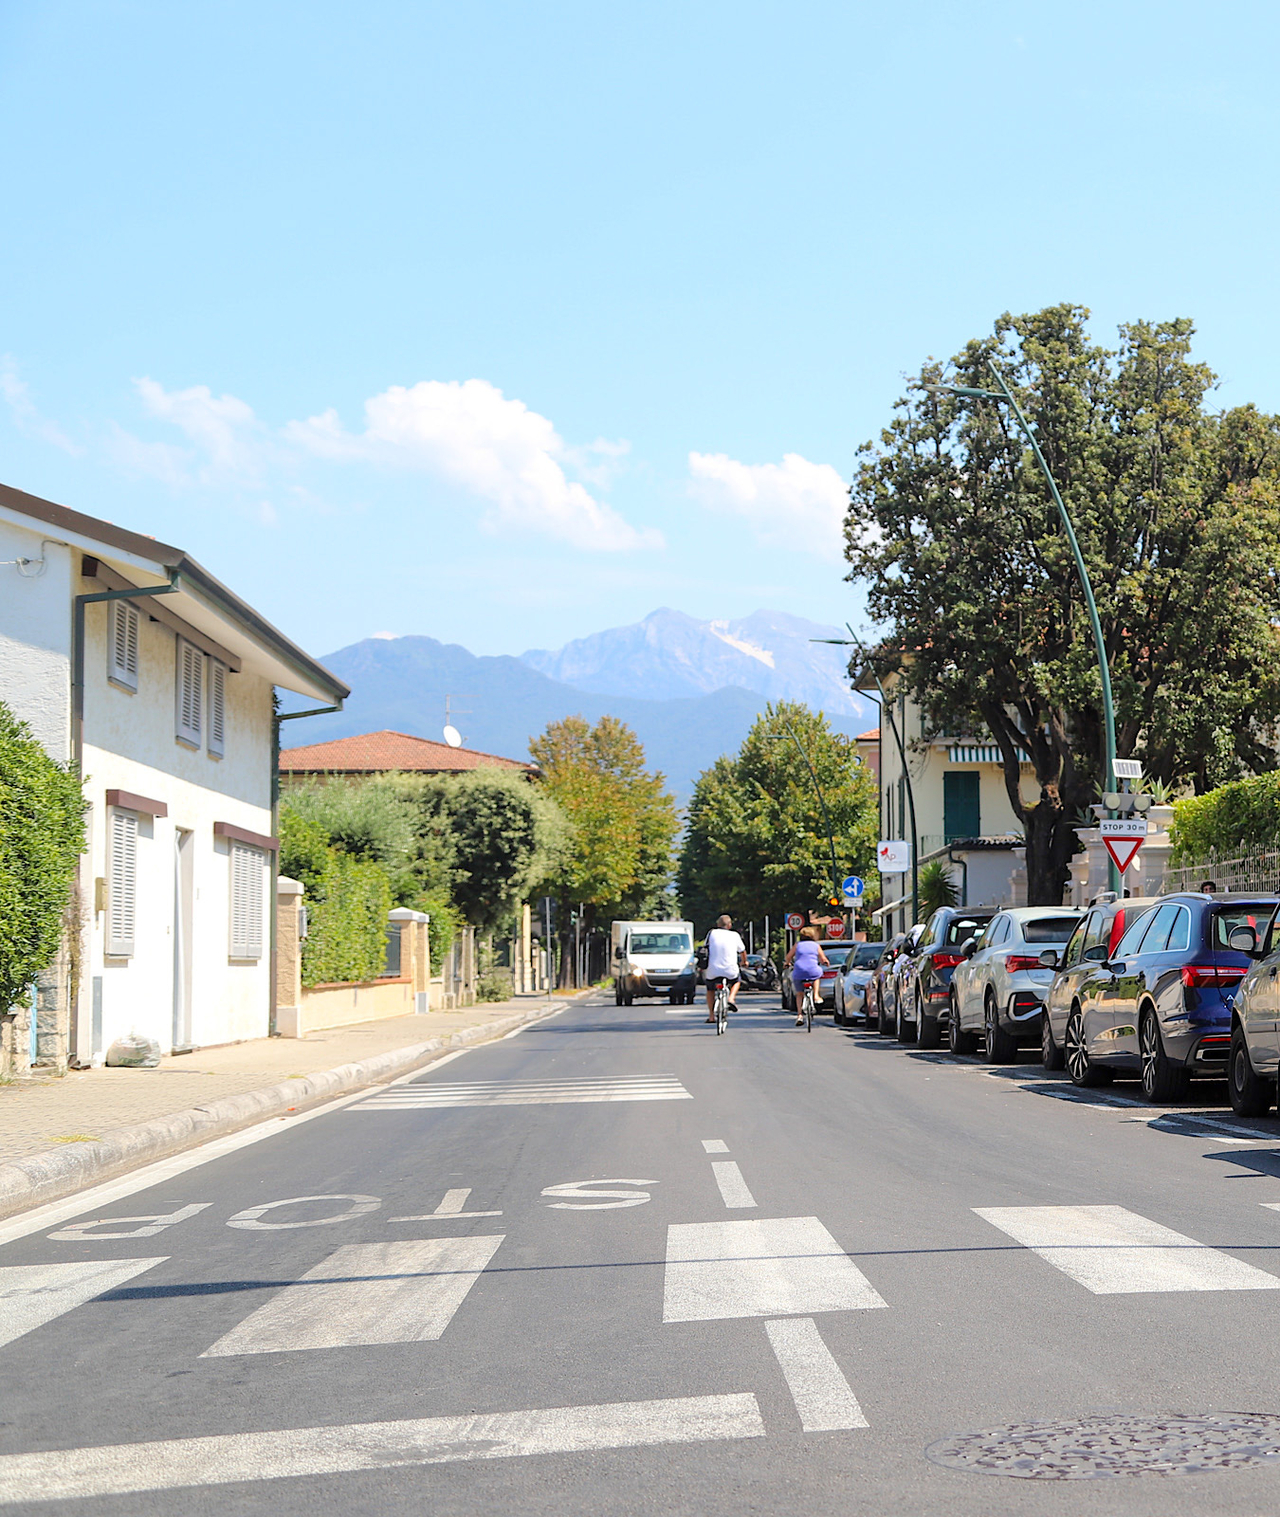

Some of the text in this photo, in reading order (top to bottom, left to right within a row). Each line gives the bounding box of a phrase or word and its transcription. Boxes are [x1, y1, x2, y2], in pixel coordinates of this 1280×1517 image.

[791, 917, 801, 926] 30
[827, 923, 843, 932] STOP
[46, 1178, 661, 1241] STOP
